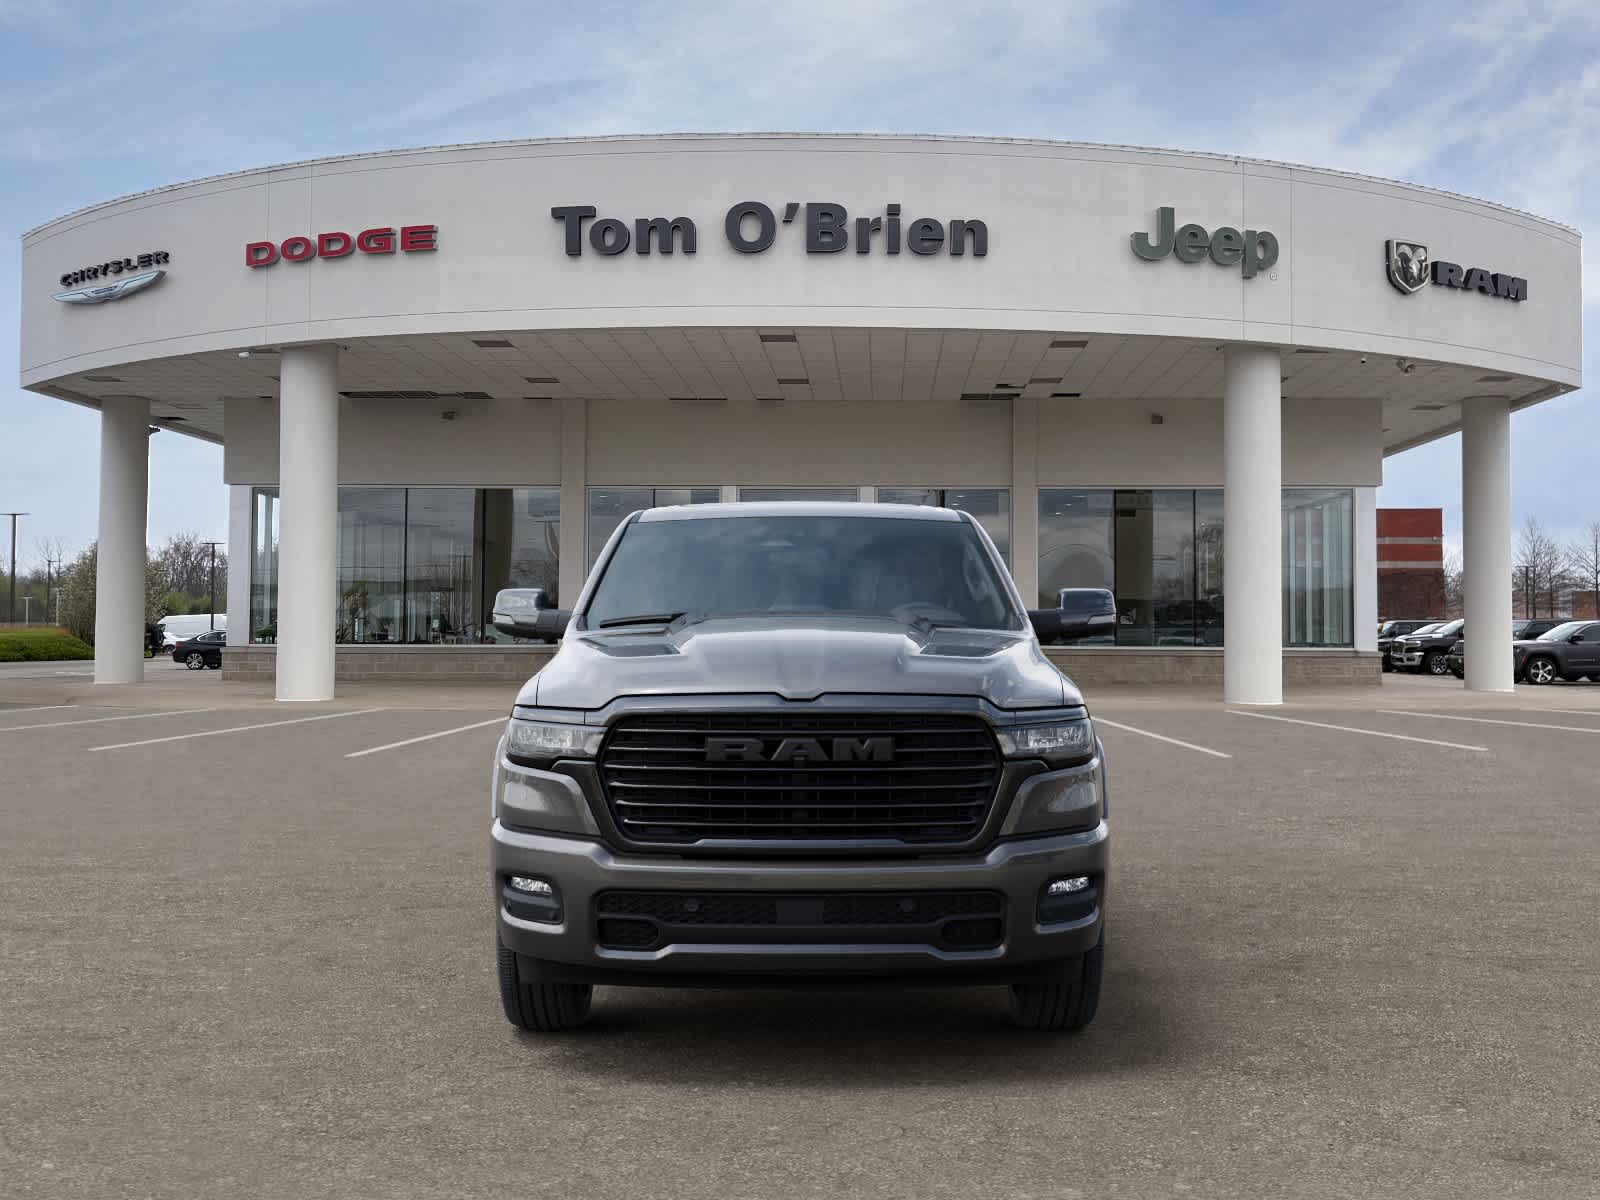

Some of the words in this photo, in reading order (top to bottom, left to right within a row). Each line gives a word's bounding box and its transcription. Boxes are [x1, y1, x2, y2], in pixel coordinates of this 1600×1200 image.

[246, 225, 437, 268] DODGE
[551, 206, 696, 256] Tom
[725, 201, 988, 257] O'Brien
[1131, 207, 1279, 279] Jeep
[60, 250, 169, 286] CHRYSLER
[1431, 261, 1527, 301] RAM
[704, 736, 895, 762] RAM
